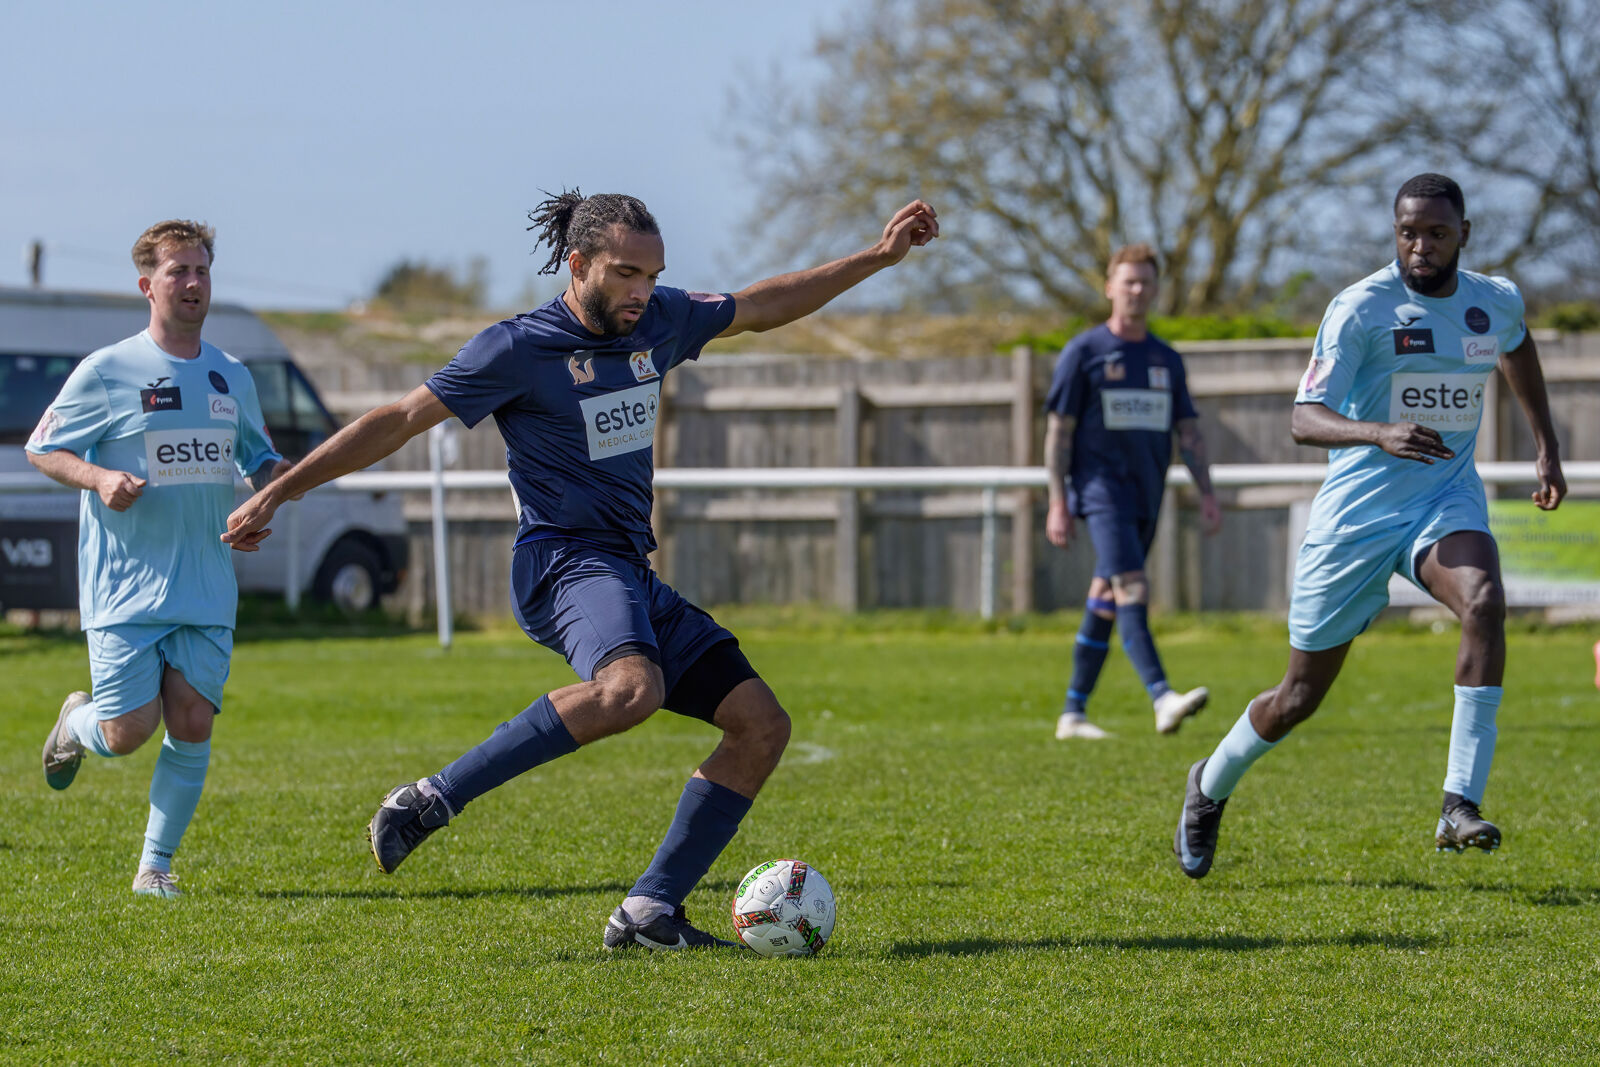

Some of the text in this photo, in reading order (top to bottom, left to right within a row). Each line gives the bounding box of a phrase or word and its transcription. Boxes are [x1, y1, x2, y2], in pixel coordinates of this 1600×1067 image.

[1401, 383, 1468, 409] este
[595, 401, 646, 434] este
[157, 438, 219, 464] este
[598, 433, 638, 448] MEDICAL
[158, 466, 207, 478] MEDICAL
